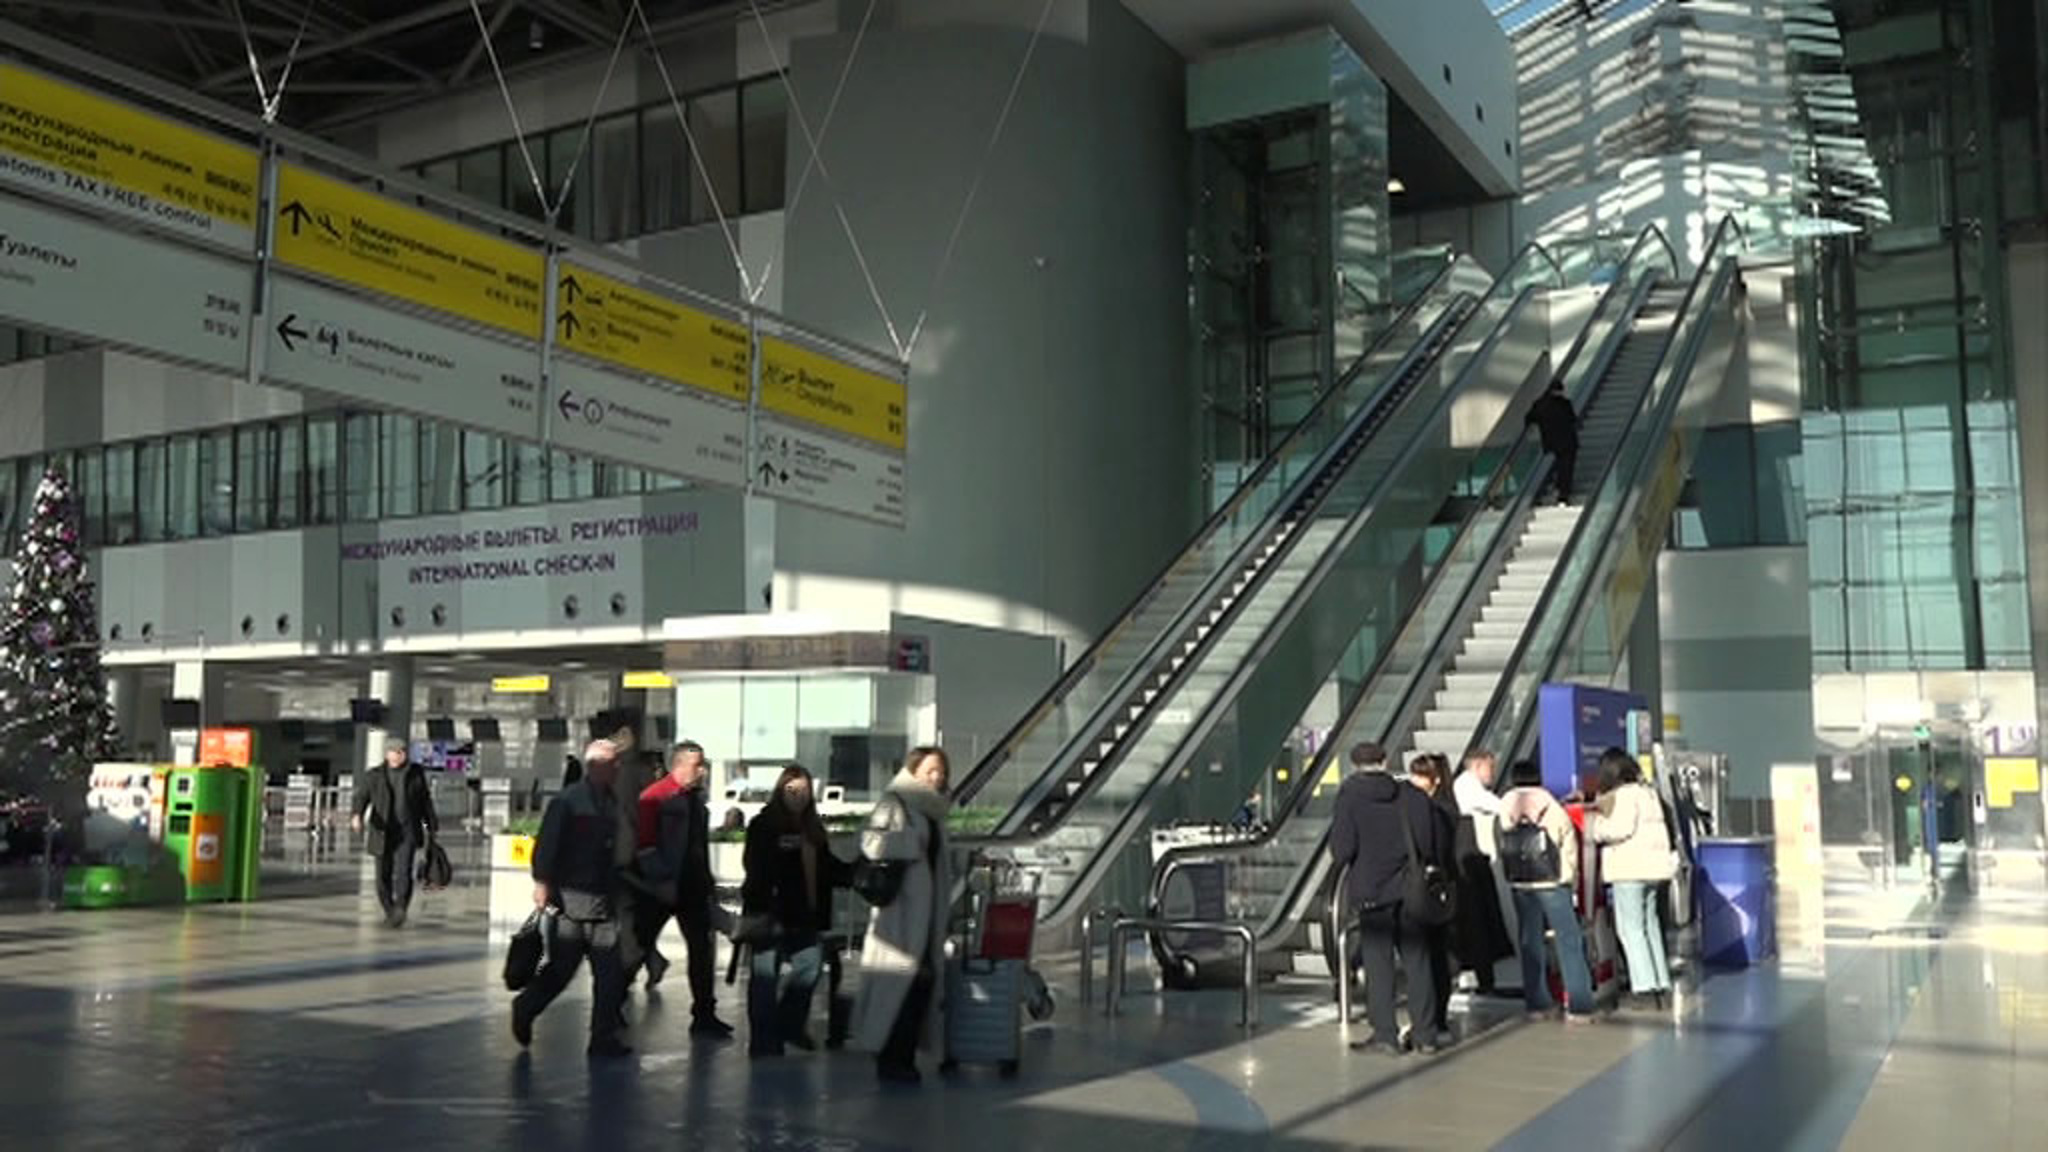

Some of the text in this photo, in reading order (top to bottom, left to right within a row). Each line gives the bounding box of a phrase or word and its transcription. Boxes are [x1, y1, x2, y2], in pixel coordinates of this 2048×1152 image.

[64, 170, 98, 194] TAX
[104, 184, 150, 212] FREE
[153, 203, 211, 231] control
[571, 510, 699, 542] РЕГИСТРАЦИЯ
[408, 552, 616, 584] INTERNATIONAL CHECK-IN
